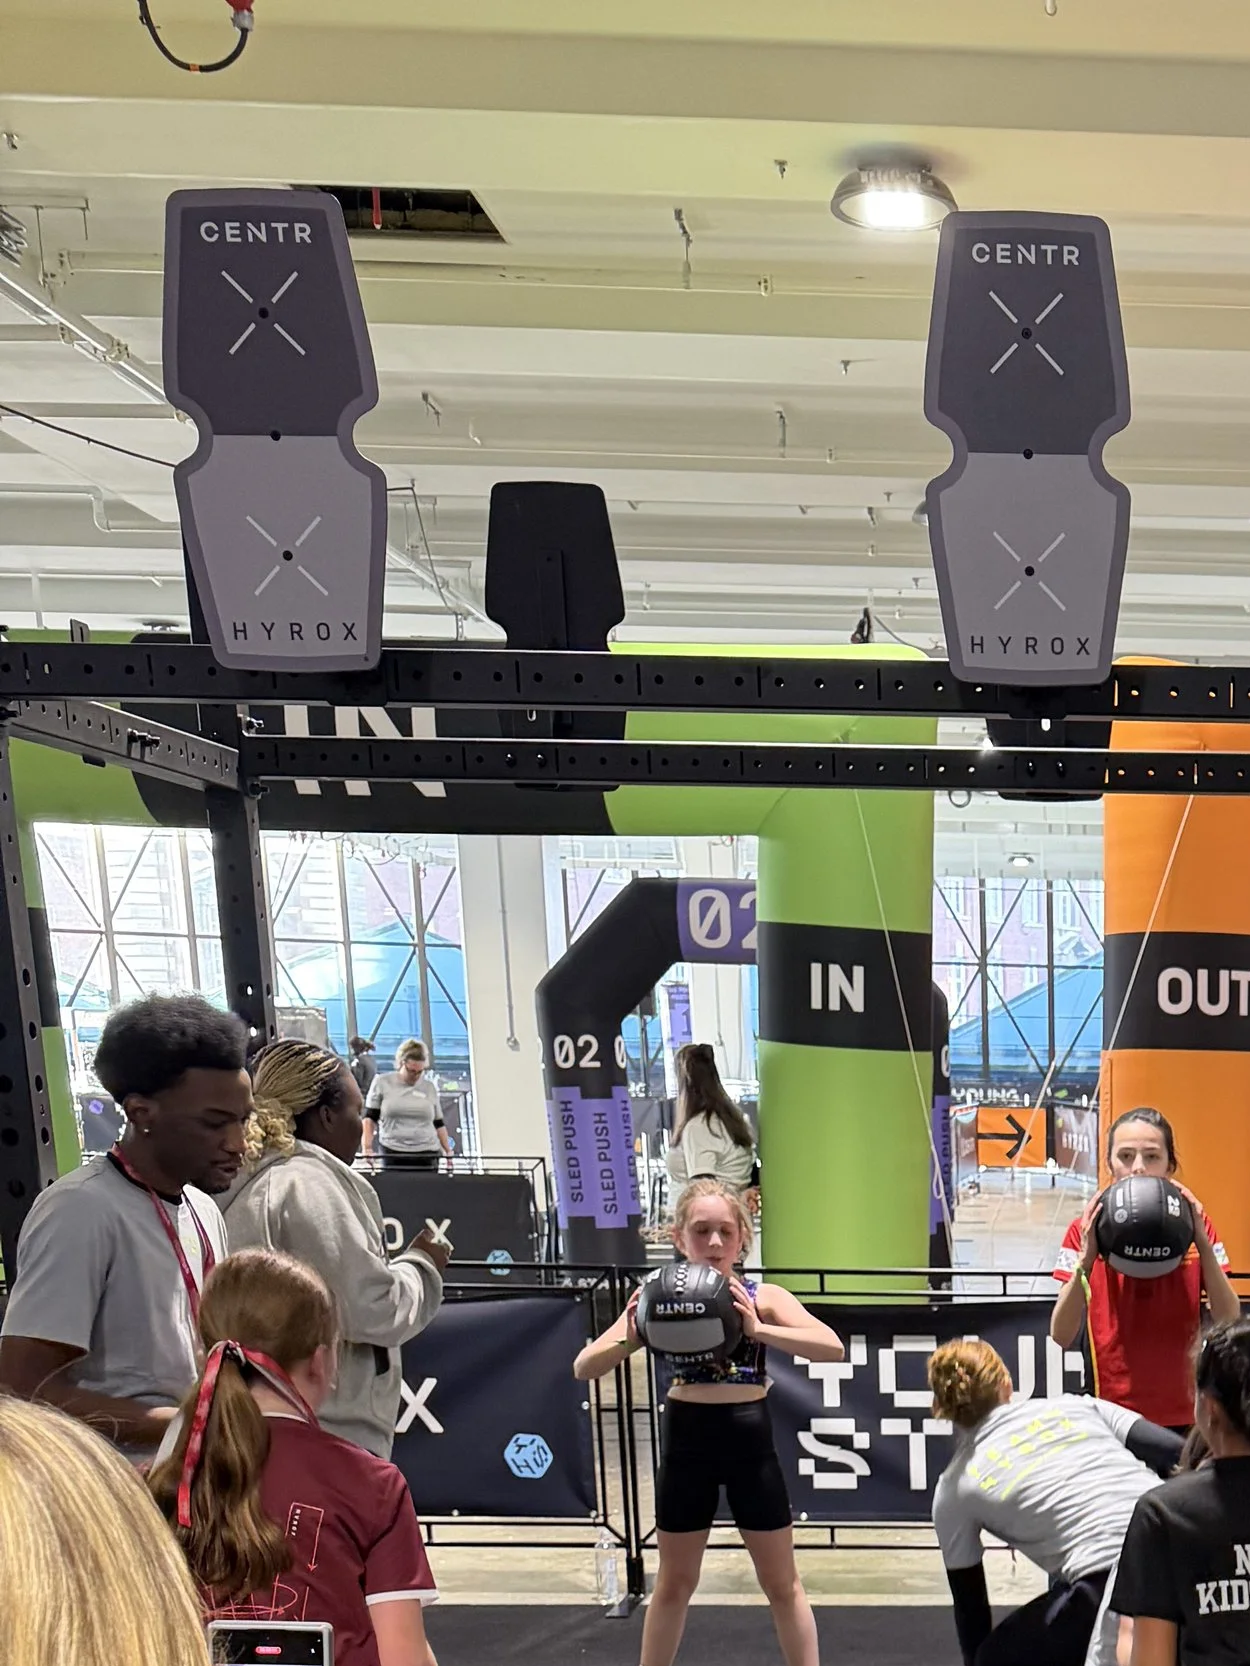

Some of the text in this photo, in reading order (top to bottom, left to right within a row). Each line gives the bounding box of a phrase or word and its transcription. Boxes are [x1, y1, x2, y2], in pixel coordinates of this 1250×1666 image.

[200, 221, 313, 245] CENTR
[971, 242, 1081, 267] CENTR
[233, 620, 359, 642] HYROX
[970, 635, 1091, 657] HYROX
[810, 962, 865, 1013] IN
[553, 1034, 601, 1070] 02
[560, 1100, 584, 1203] SLED PUSH
[593, 1112, 618, 1215] SLED PUSH
[1124, 1245, 1171, 1257] CENTR
[655, 1301, 706, 1315] CENTR
